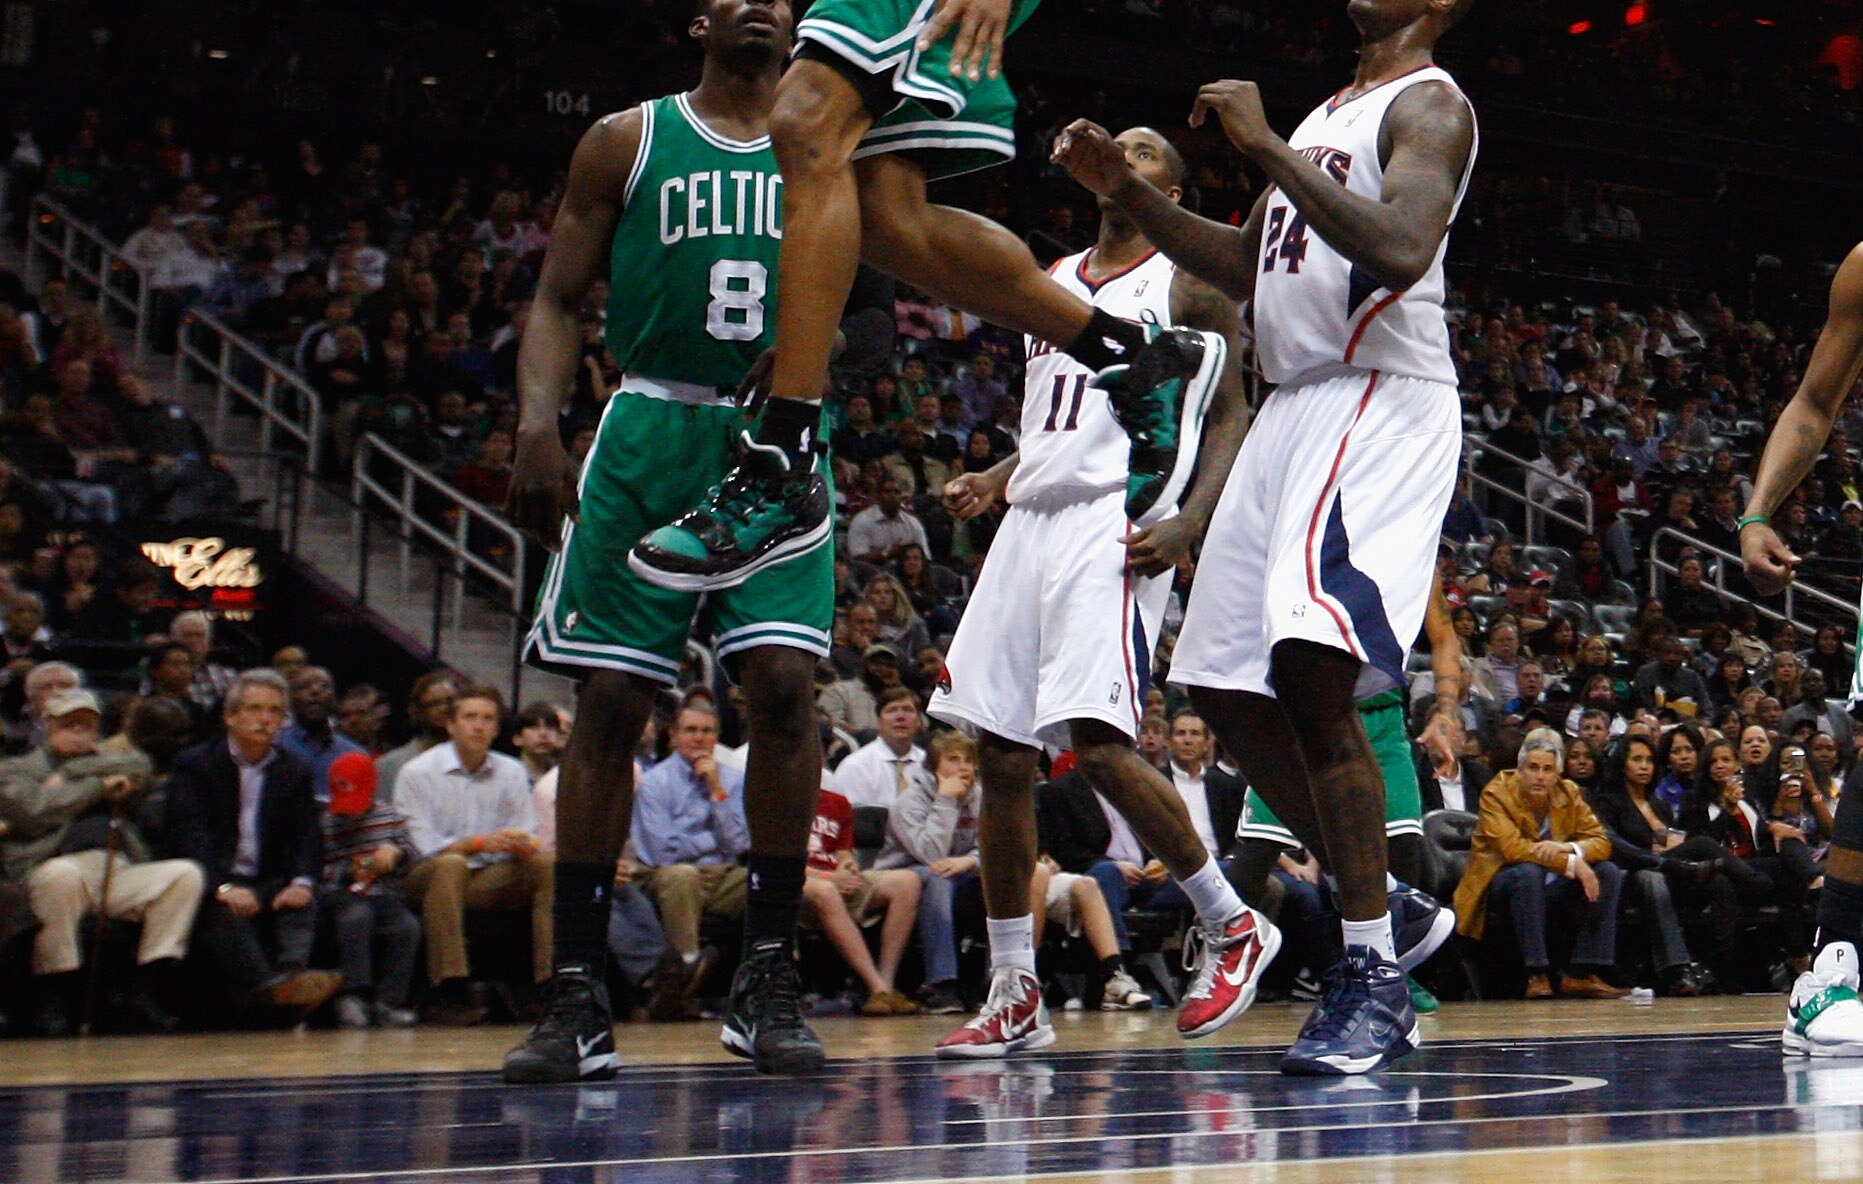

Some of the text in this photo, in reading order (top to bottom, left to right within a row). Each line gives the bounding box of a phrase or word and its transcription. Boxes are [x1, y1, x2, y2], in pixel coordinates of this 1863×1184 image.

[544, 90, 591, 117] 104
[660, 170, 784, 246] CELTIC
[1263, 205, 1309, 274] 24
[706, 259, 768, 341] 8
[1043, 373, 1089, 432] 11
